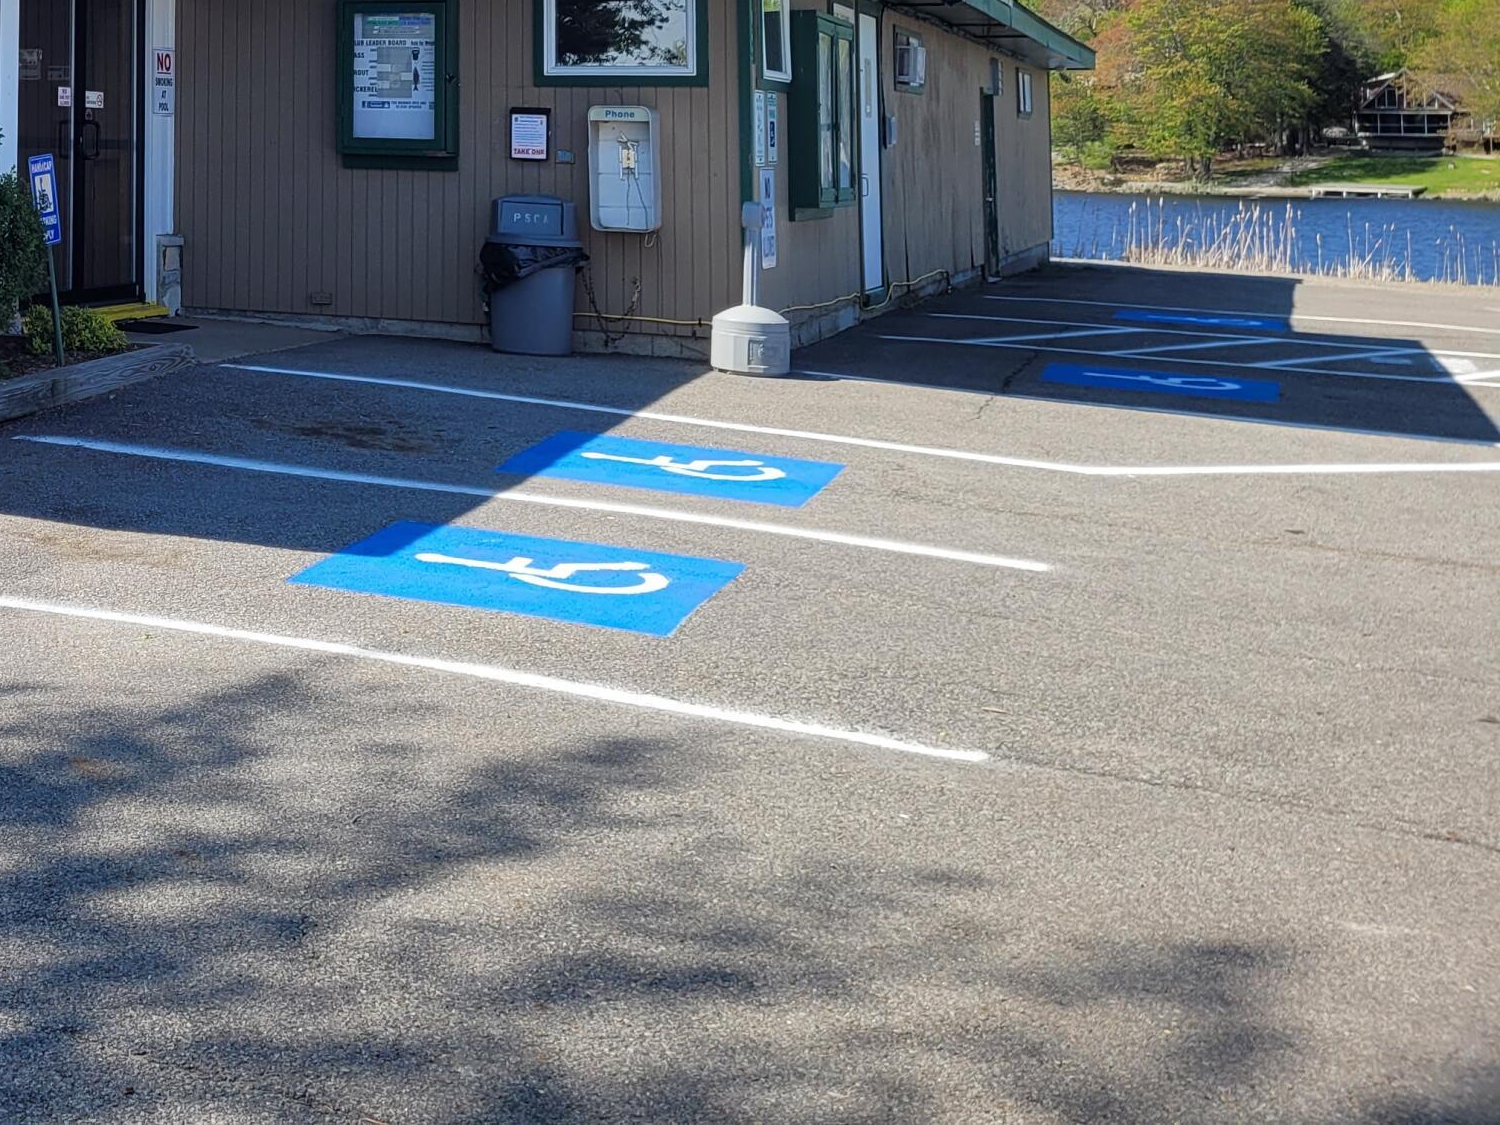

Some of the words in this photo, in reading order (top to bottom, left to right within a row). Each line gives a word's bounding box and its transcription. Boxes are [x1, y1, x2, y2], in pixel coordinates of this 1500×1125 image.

[157, 53, 171, 72] NO
[156, 77, 172, 86] SMOKING
[605, 110, 635, 118] Phone
